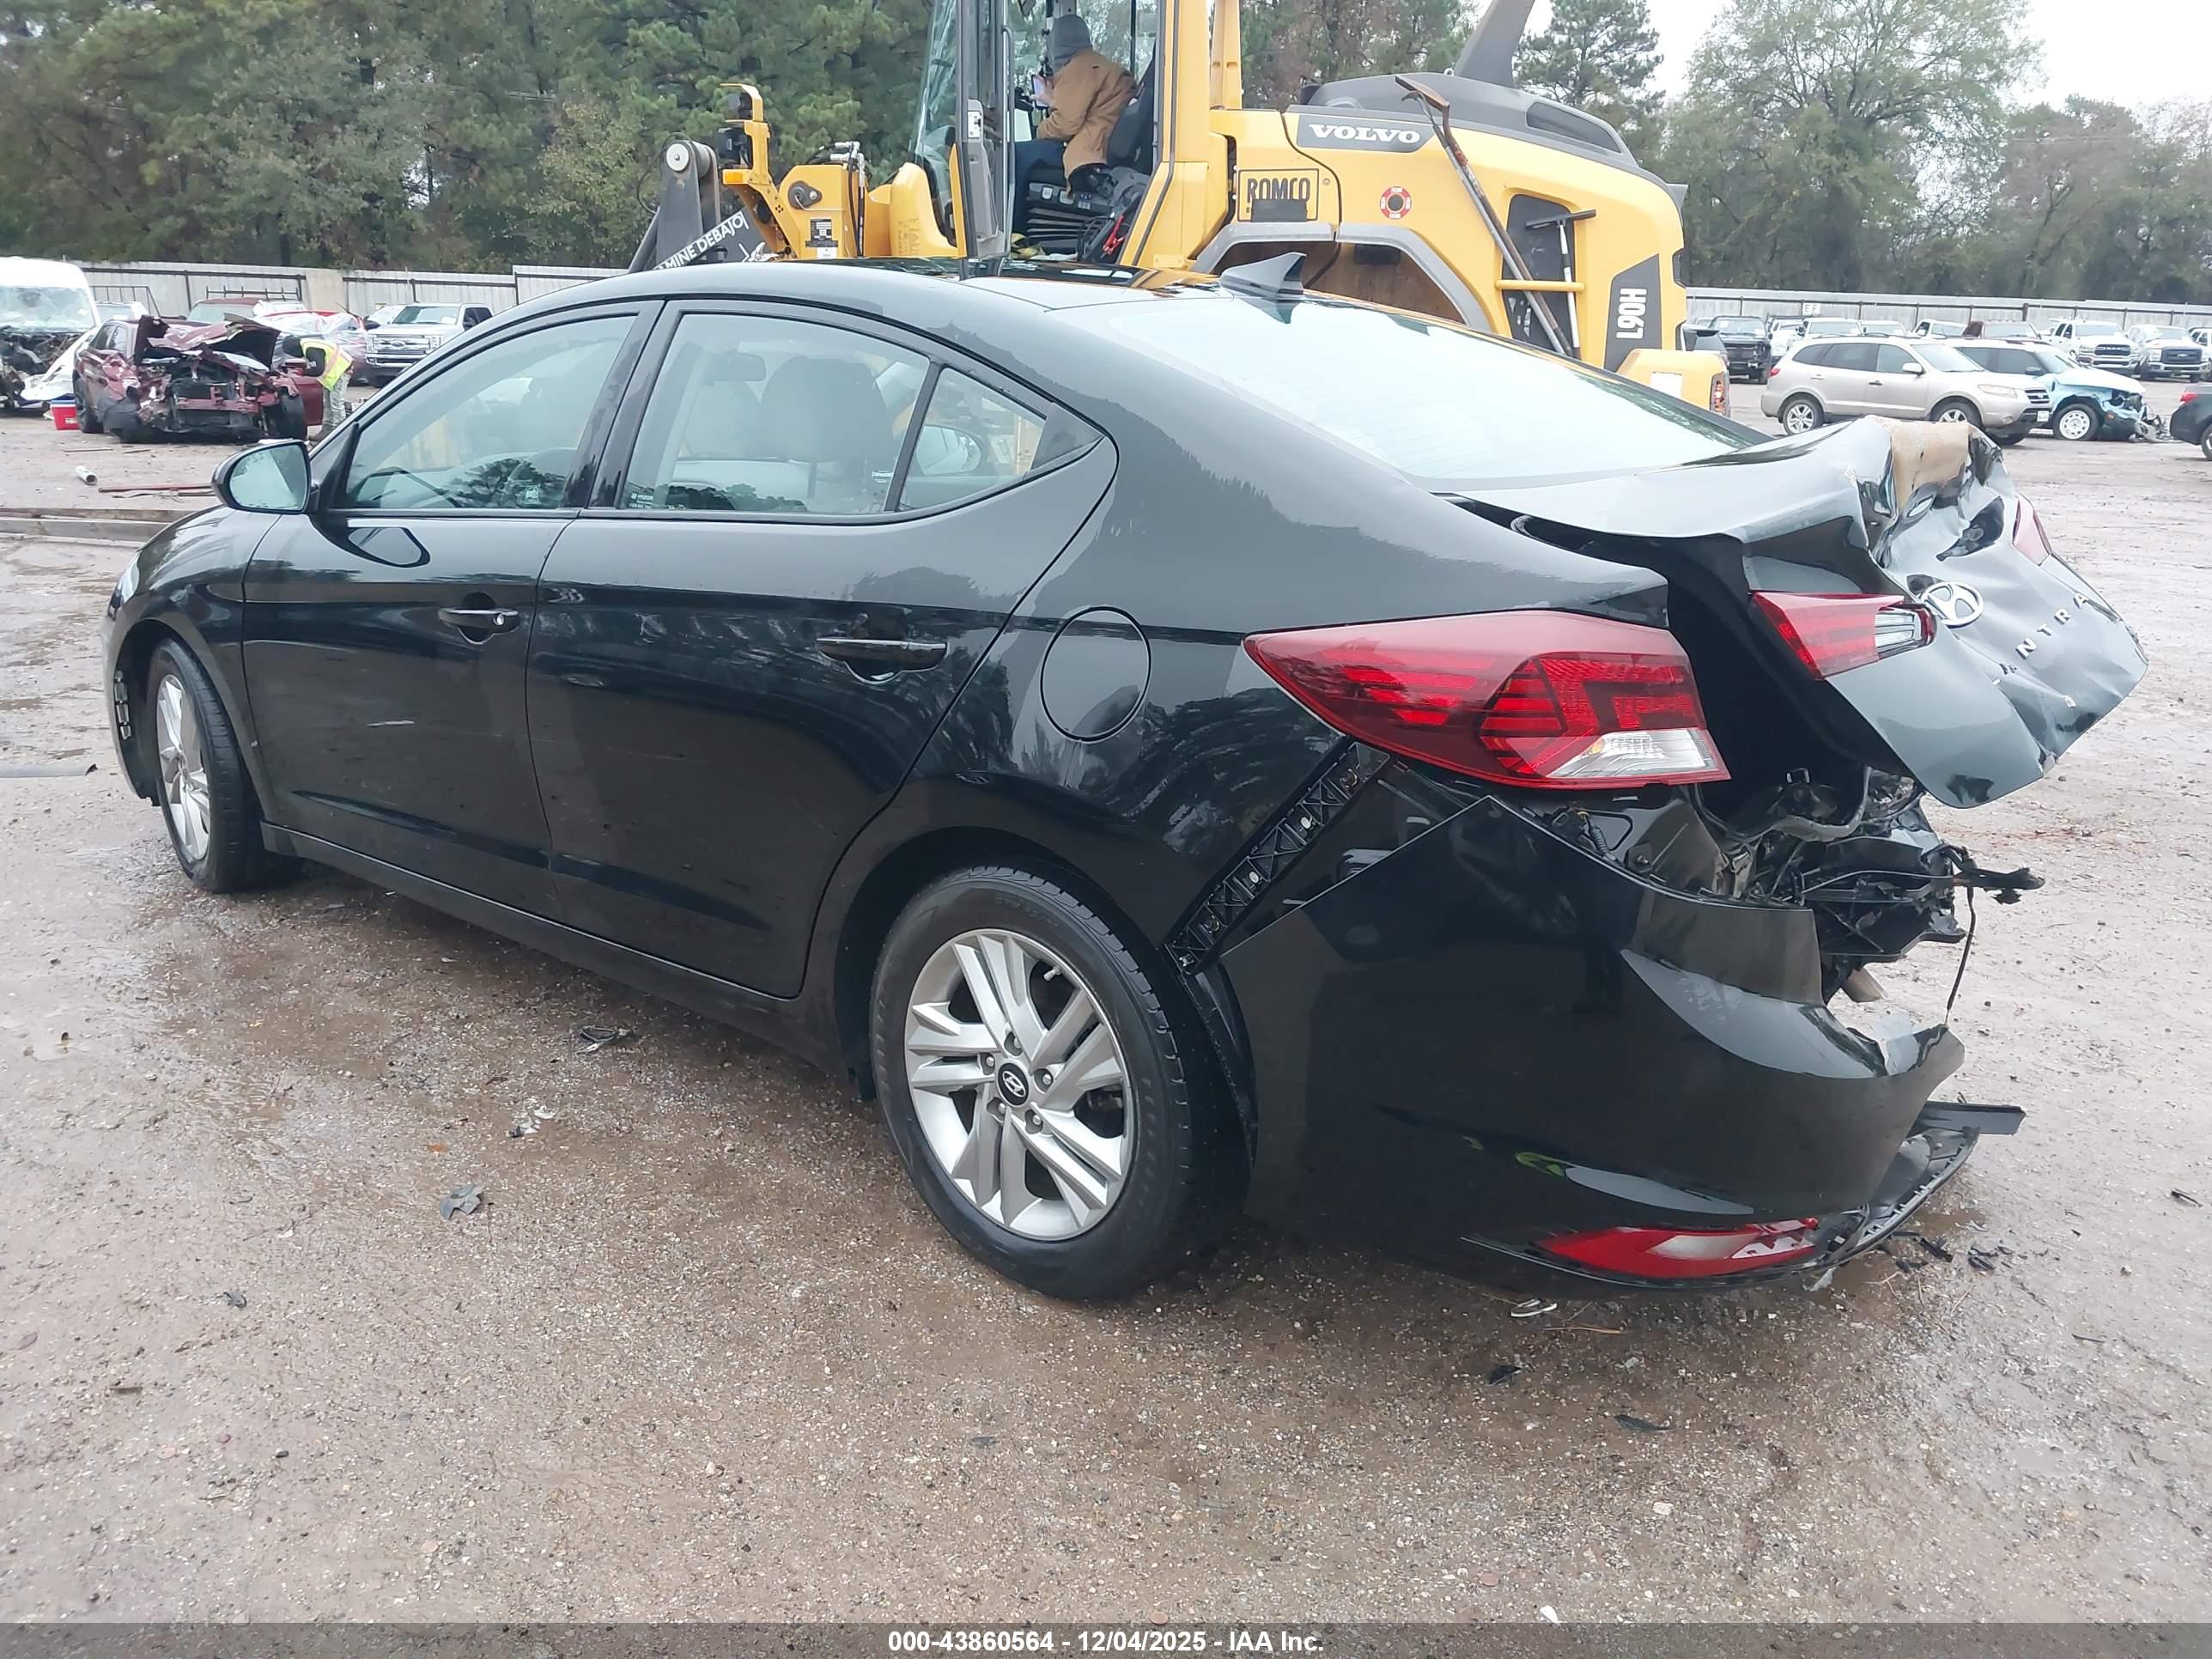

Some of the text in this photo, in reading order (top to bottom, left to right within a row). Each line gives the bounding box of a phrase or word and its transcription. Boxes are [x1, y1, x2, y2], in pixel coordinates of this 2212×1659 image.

[1309, 124, 1420, 143] VOLVO
[1247, 177, 1310, 204] ROMCO
[696, 215, 744, 252] DEBAJO
[1616, 288, 1647, 339] L90H
